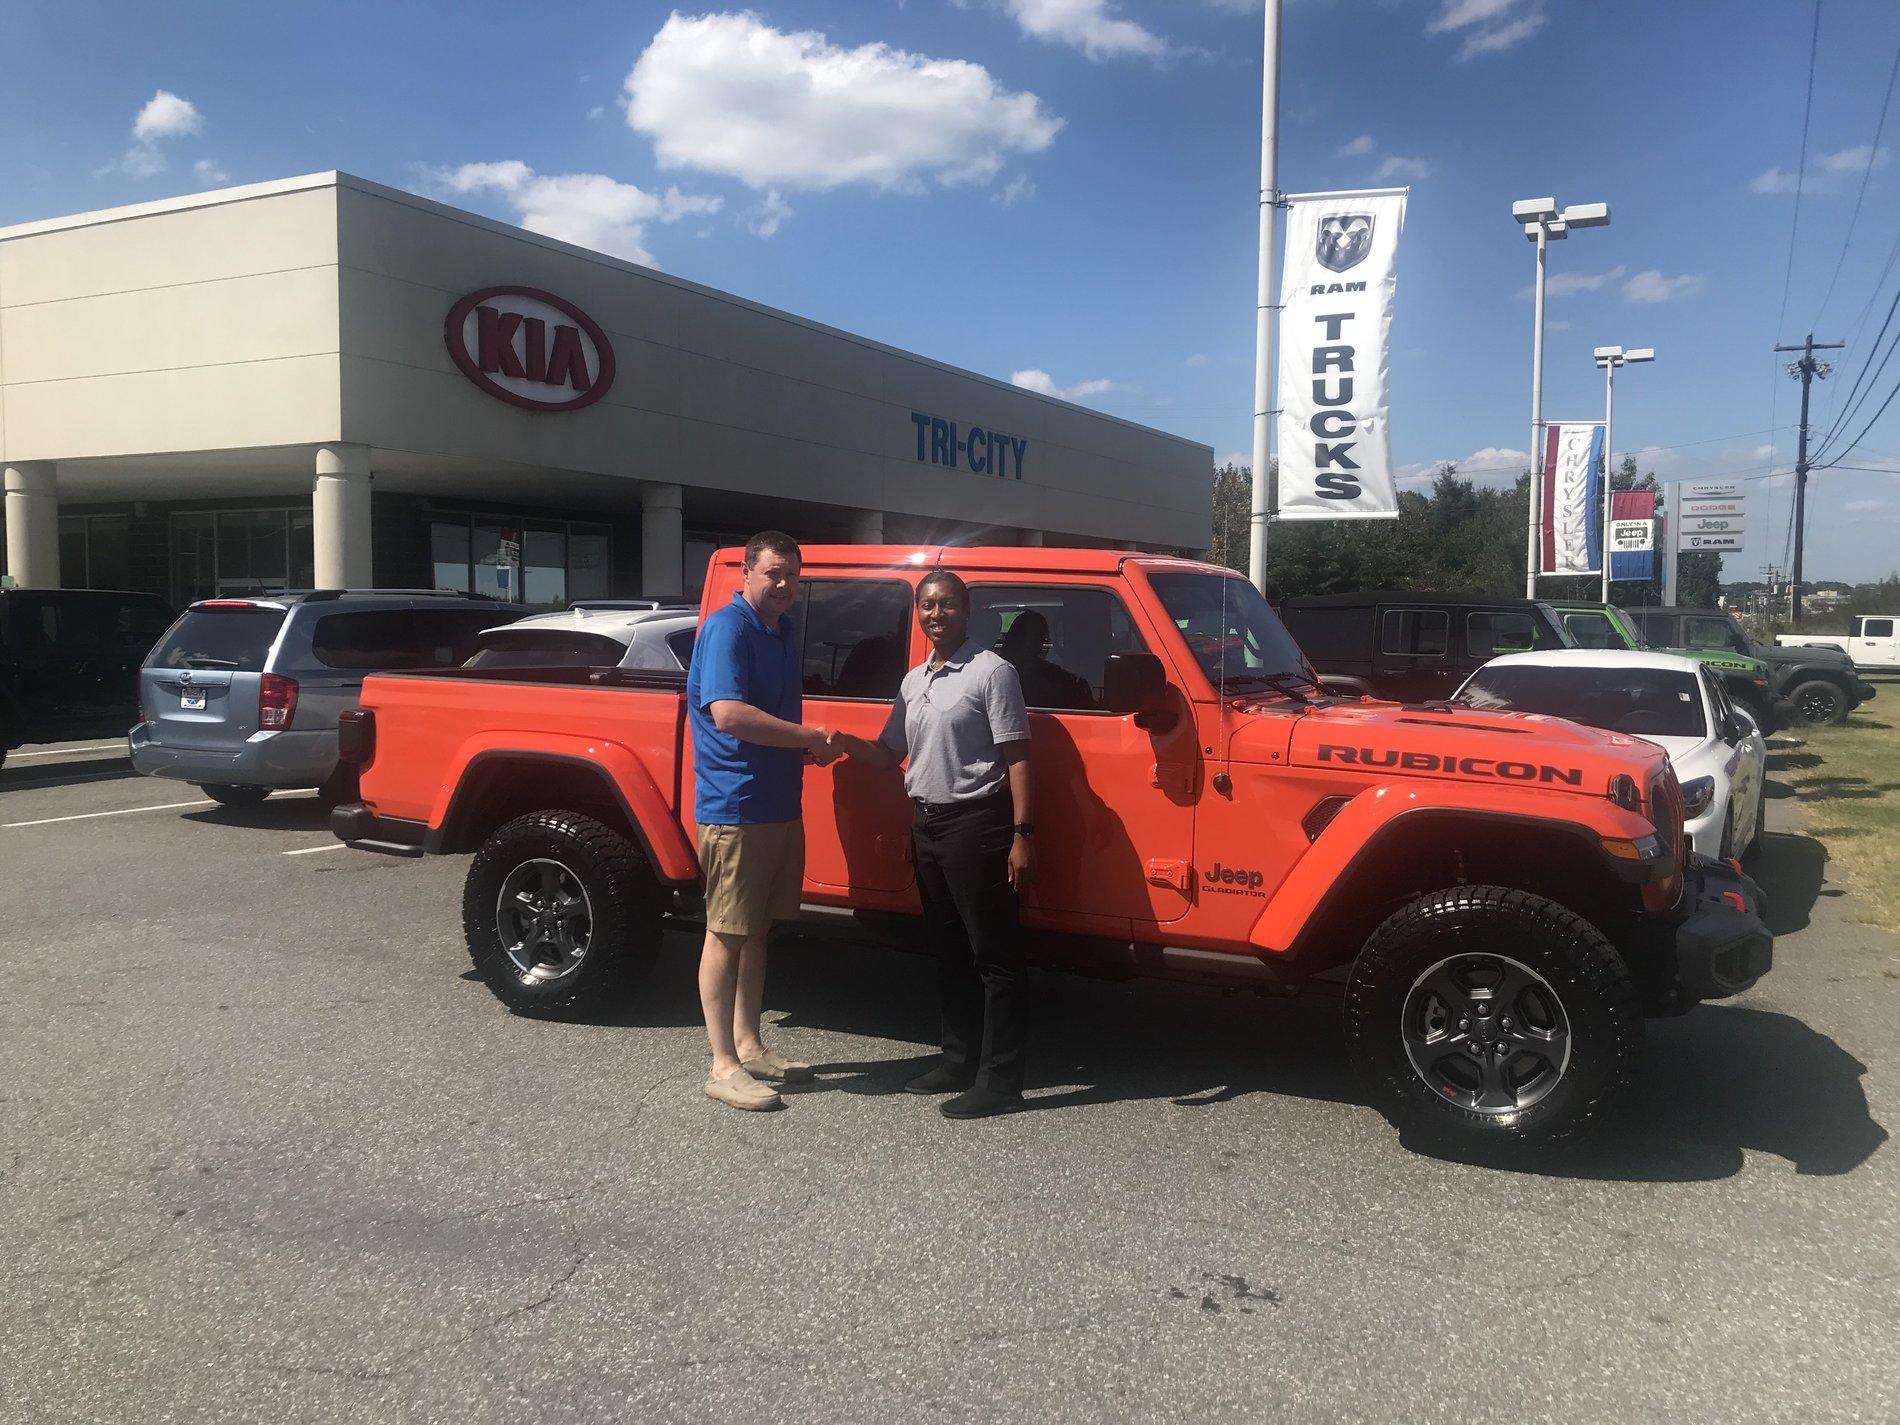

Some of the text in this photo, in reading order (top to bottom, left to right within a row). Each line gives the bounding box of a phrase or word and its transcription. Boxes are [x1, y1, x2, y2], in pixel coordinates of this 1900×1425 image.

[1310, 281, 1367, 295] RAM
[475, 306, 592, 391] KIA
[1310, 313, 1362, 500] TRUCKS
[911, 412, 1027, 480] TRI-CITY
[1562, 438, 1581, 569] CHRYSLER
[1620, 529, 1643, 537] Jeep
[1697, 519, 1729, 530] Jeep
[1317, 743, 1583, 786] RUBICON
[1202, 885, 1266, 898] GLADIATOR
[1204, 862, 1264, 890] Jeep
